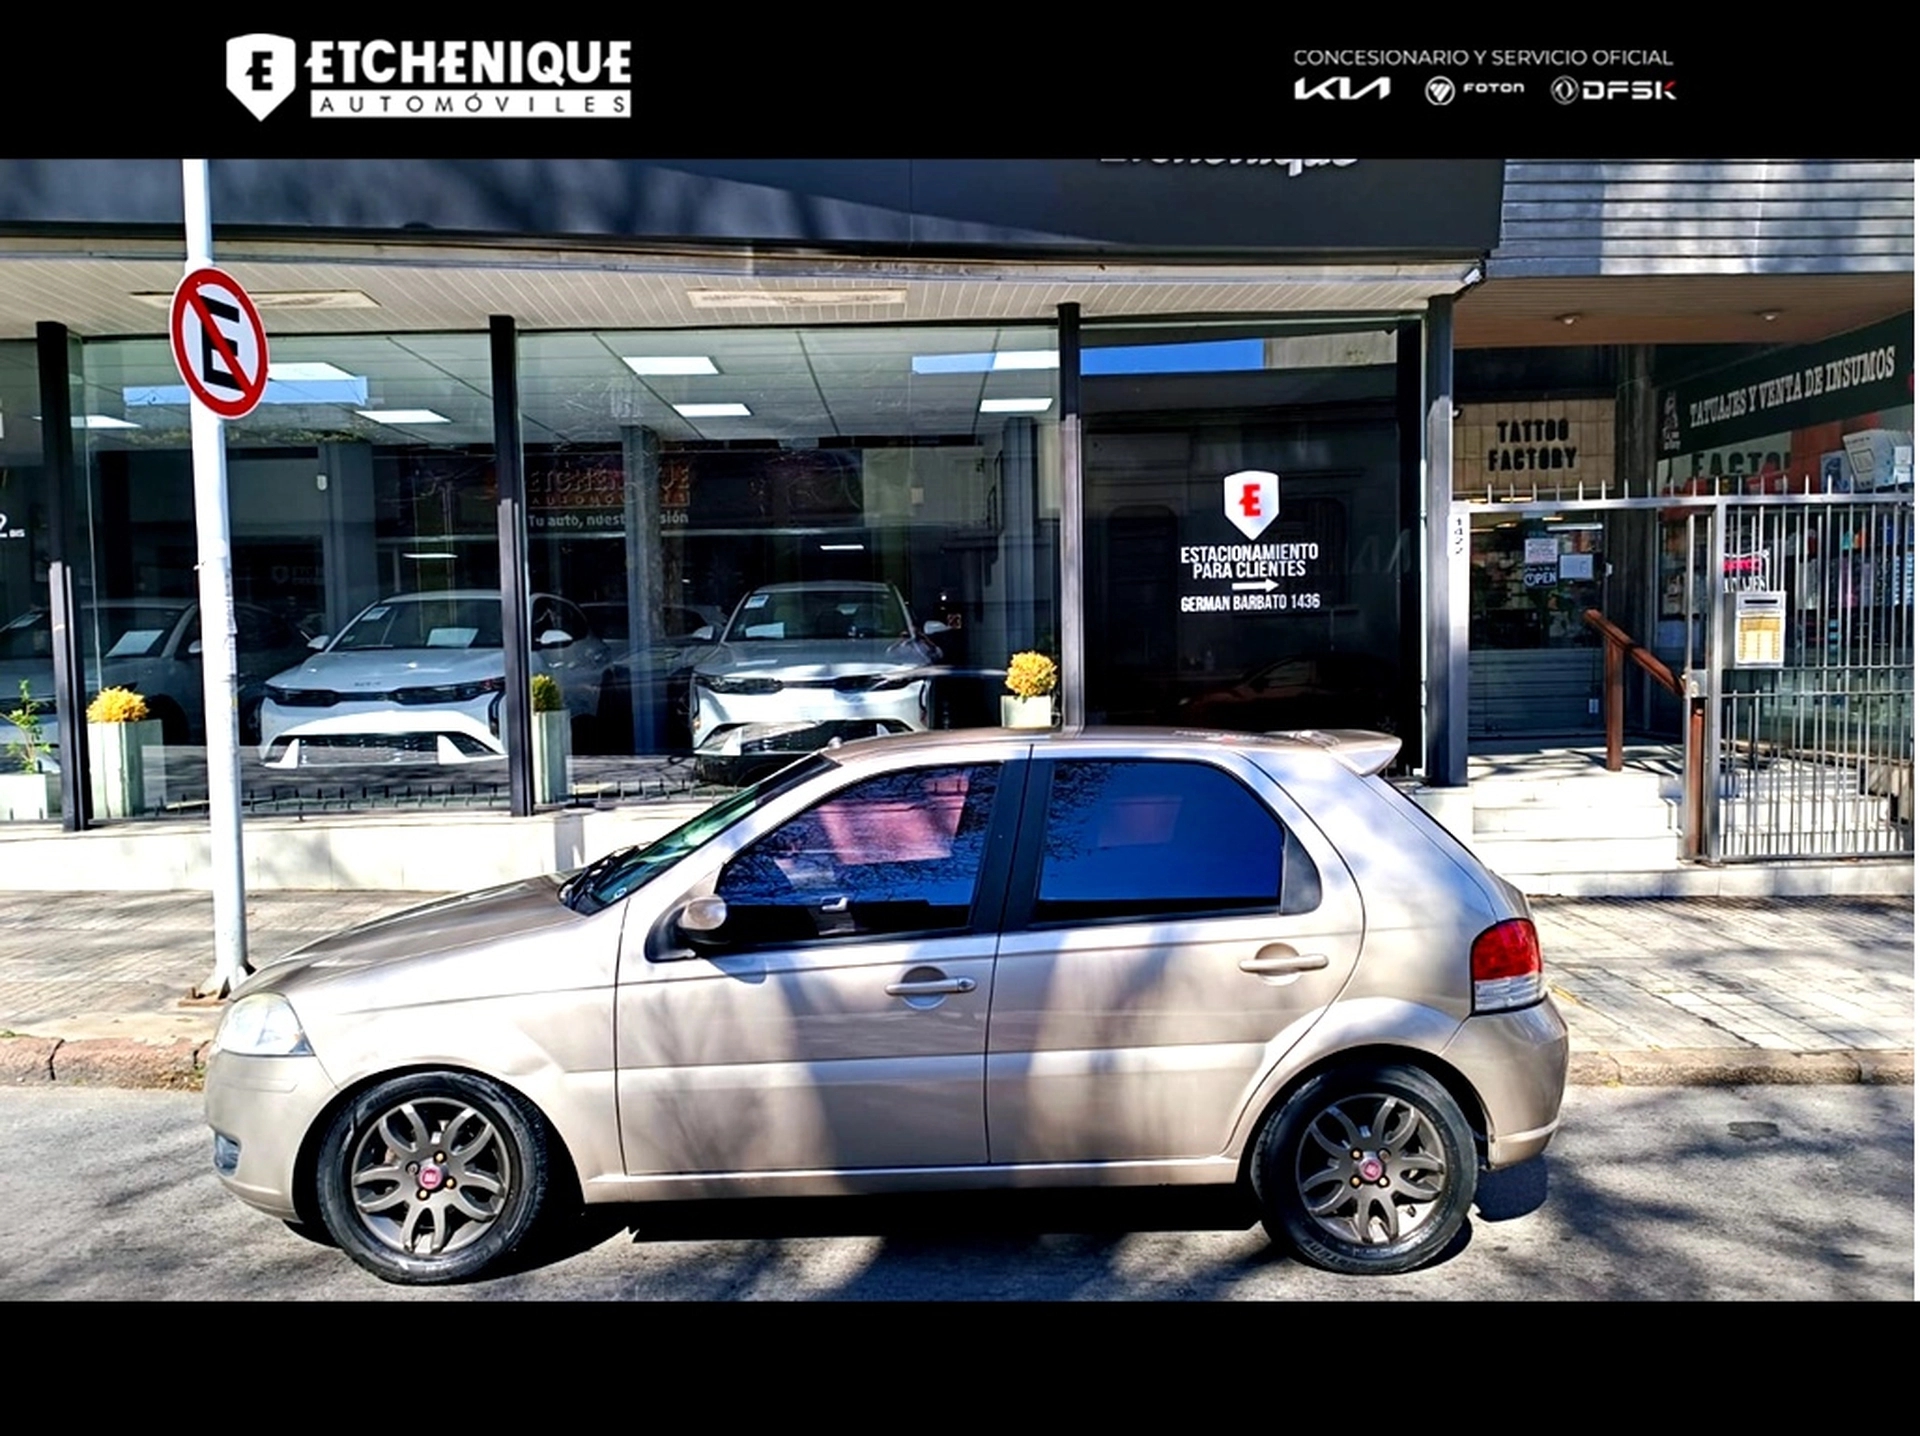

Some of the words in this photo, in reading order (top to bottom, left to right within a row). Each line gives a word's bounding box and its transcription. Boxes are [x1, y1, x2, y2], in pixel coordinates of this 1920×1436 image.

[200, 294, 246, 392] E
[1690, 388, 1746, 428] TATUAJES
[1748, 385, 1757, 412] Y
[1759, 371, 1802, 409] VENTA
[1804, 366, 1823, 398] DE
[1825, 344, 1895, 392] INSUMOS
[1497, 418, 1569, 443] TATTOO
[1488, 447, 1577, 471] FACTORY
[1239, 484, 1261, 517] E
[1180, 542, 1319, 564] ESTACIONAMIENTO
[1193, 561, 1233, 580] PARA
[1236, 560, 1306, 579] CLIENTES
[1180, 595, 1231, 612] GERMAN
[1233, 594, 1288, 611] BARBATO
[1291, 593, 1321, 609] 1436
